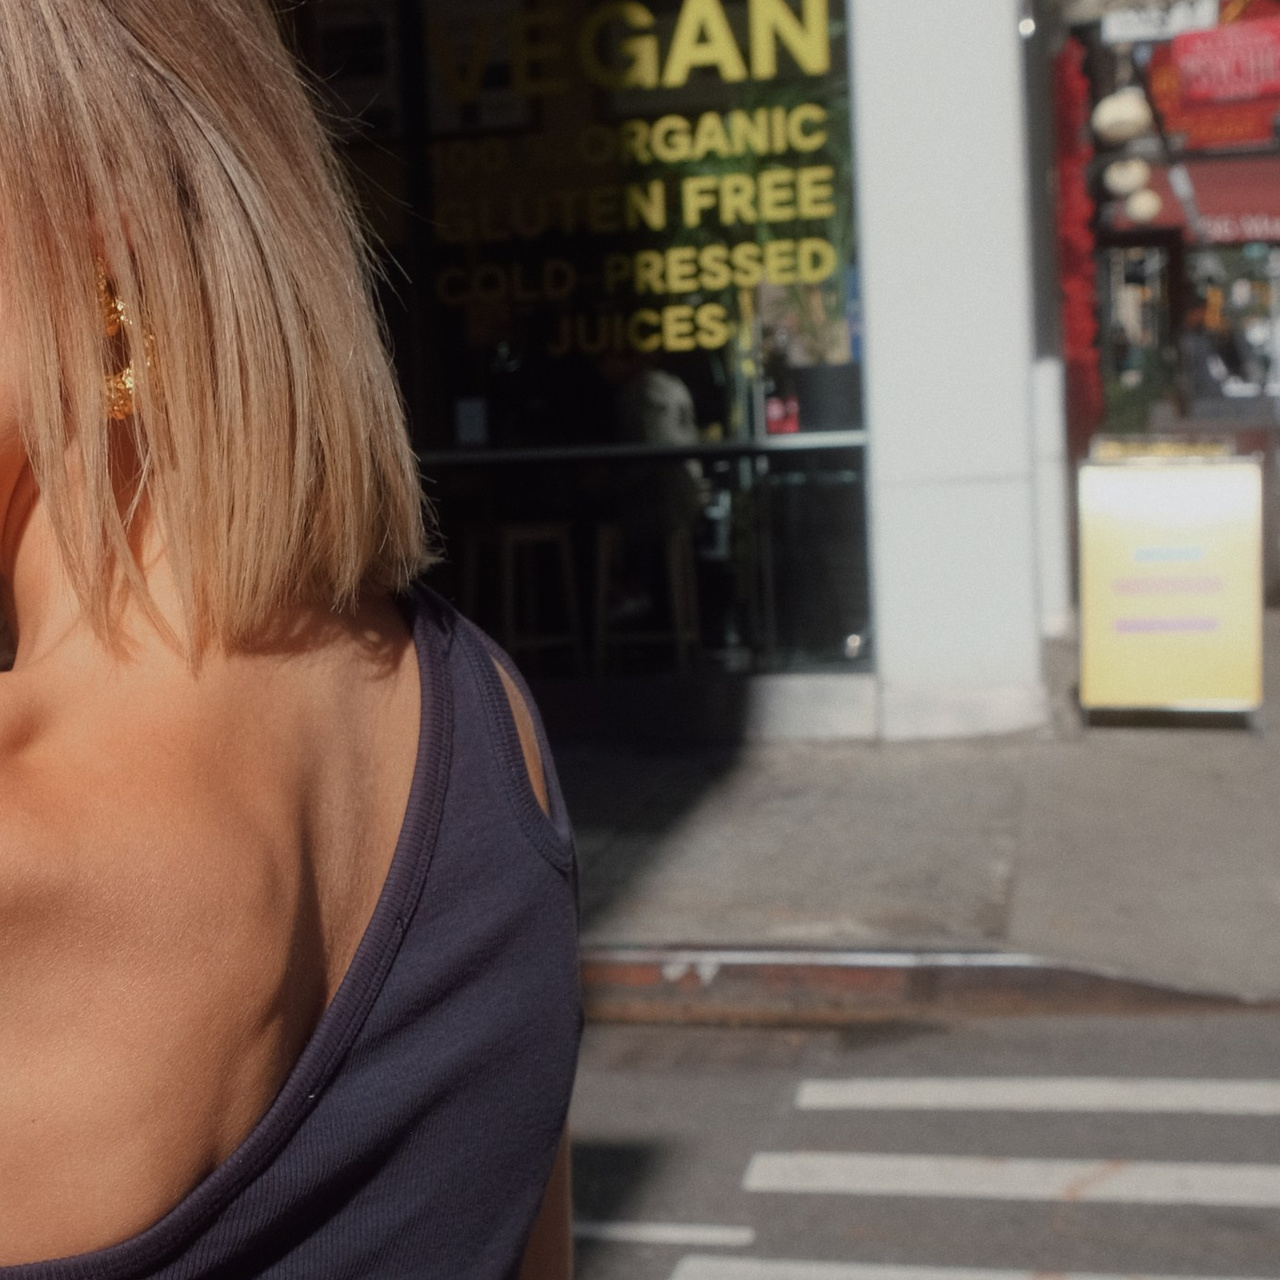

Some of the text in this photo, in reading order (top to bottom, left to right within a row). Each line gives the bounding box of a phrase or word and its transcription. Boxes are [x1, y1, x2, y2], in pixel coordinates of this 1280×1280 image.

[578, 104, 826, 165] ORGANIC
[436, 166, 835, 242] GLUTEN FREE
[549, 304, 729, 356] JUICES
